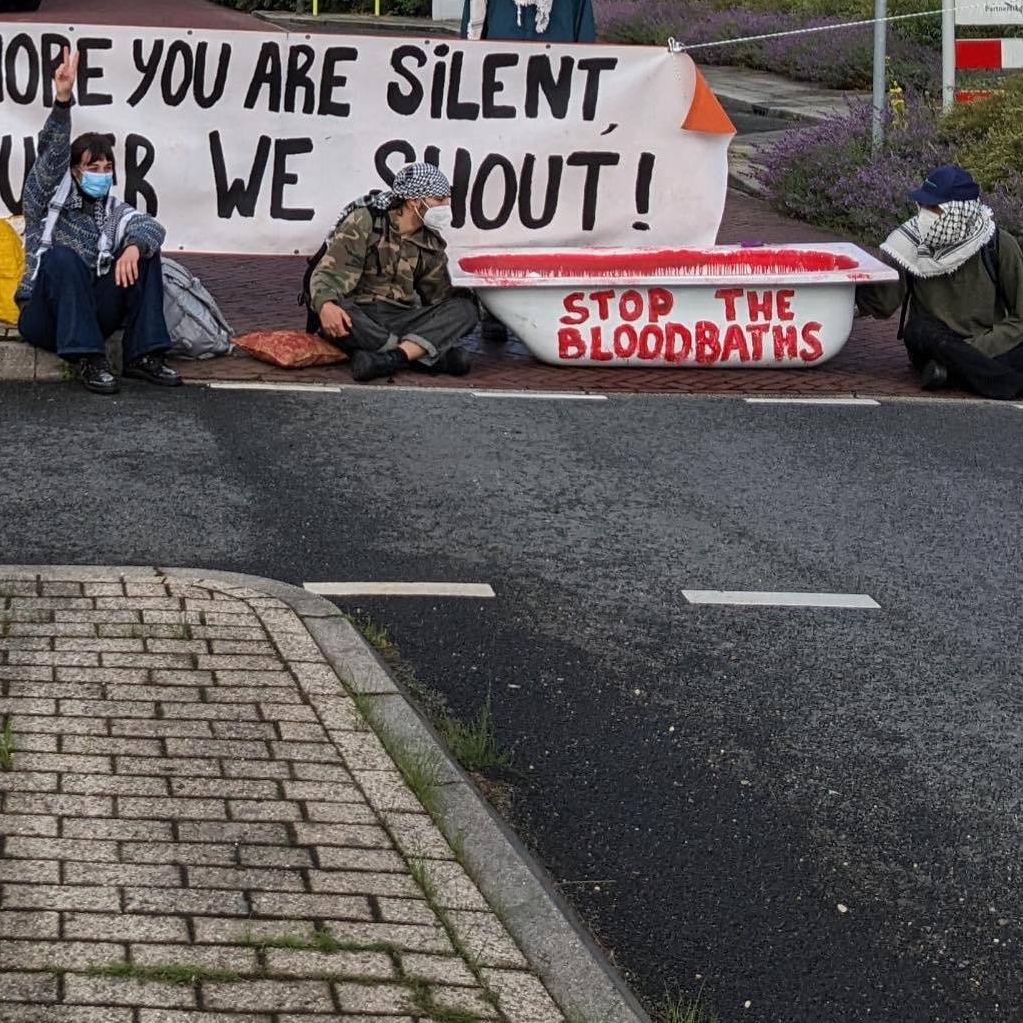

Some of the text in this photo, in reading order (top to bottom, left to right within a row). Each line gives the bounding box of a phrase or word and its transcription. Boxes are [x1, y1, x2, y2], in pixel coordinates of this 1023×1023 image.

[126, 38, 232, 109] YOU
[243, 40, 358, 117] ARE
[209, 129, 315, 221] WE
[559, 287, 795, 325] STOP THE
[557, 320, 823, 364] BLOODBATHS
